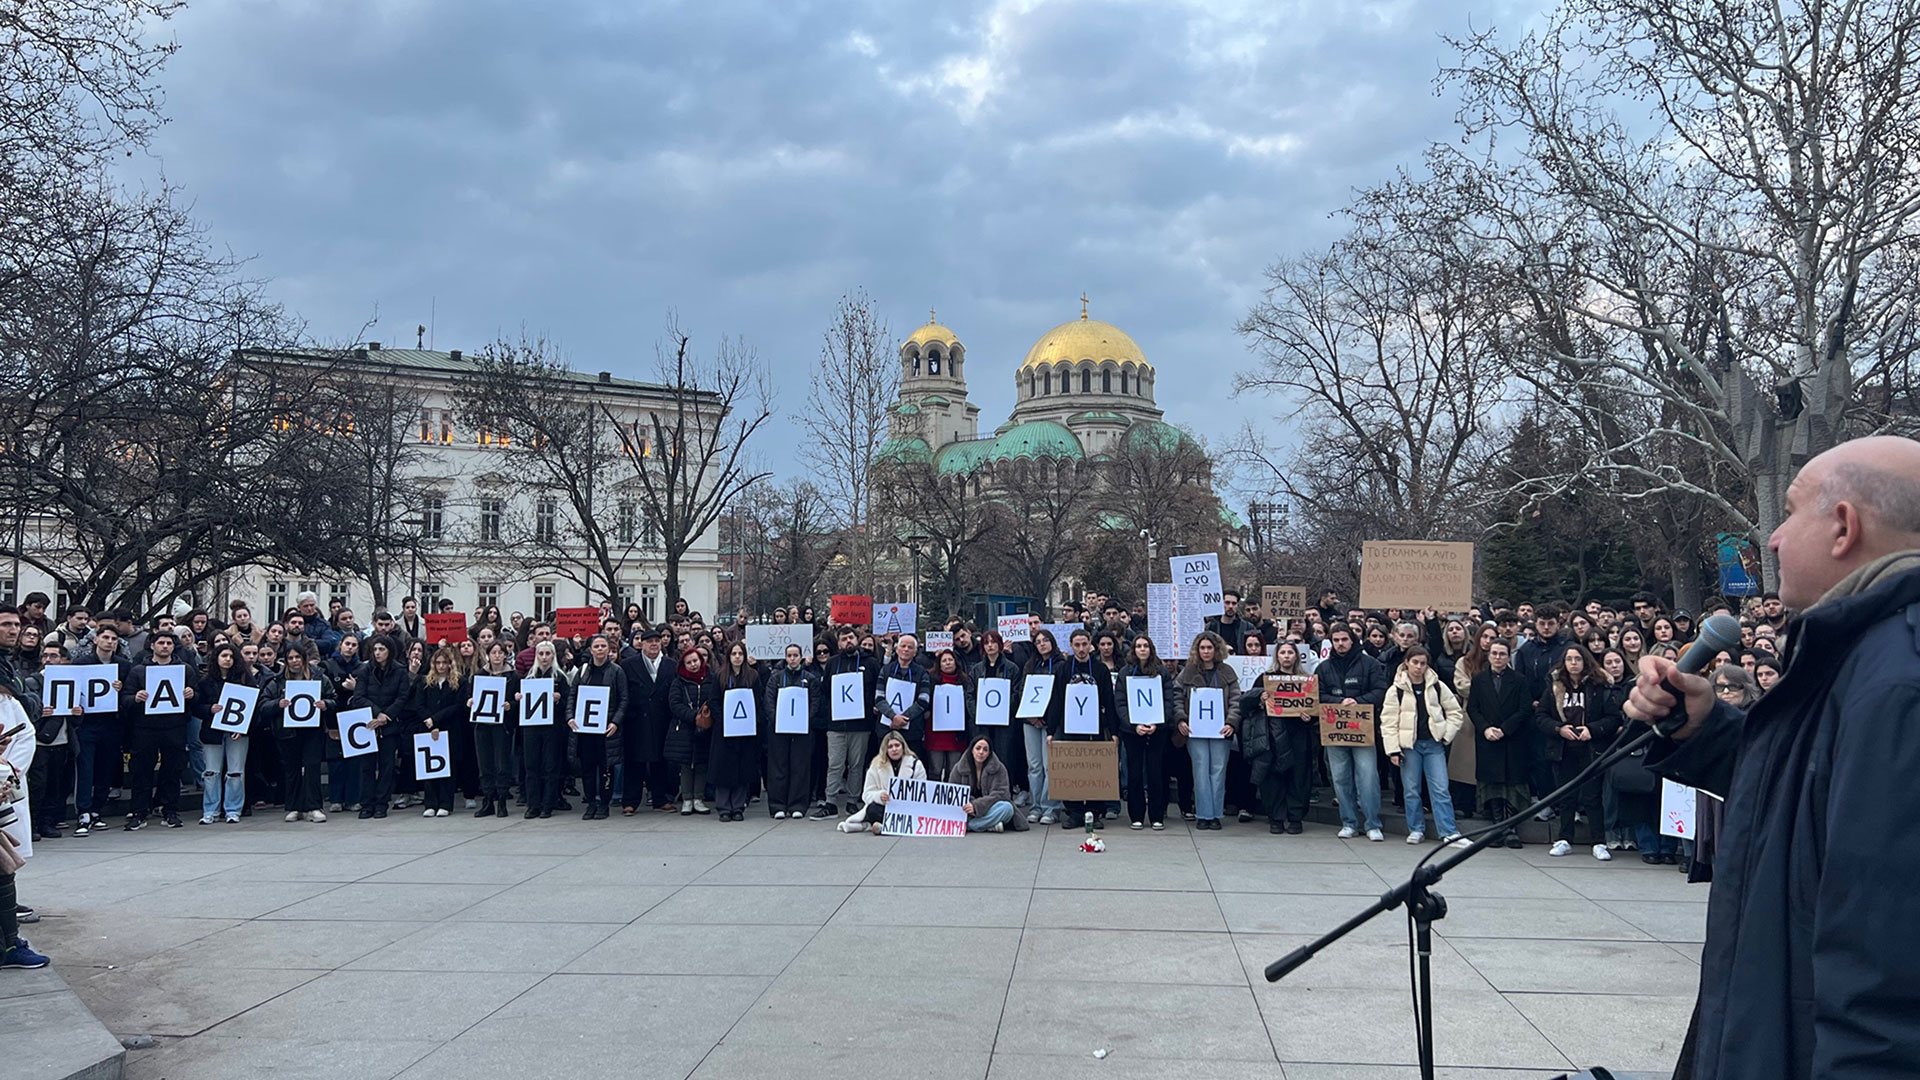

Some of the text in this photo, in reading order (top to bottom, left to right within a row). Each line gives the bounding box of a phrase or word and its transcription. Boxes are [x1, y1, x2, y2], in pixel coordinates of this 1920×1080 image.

[1366, 546, 1457, 559] ΤΟ ΕΓΚΛΗΜΑ ΑΥΤΟ
[1184, 560, 1210, 573] ΔΕΝ
[1368, 561, 1381, 571] ΝΑ
[1385, 561, 1403, 570] ΜΗ
[1264, 591, 1301, 600] ΠΑΡΕ ΜΕ
[877, 610, 888, 619] 57
[767, 626, 791, 636] ΟΧΙ
[769, 635, 792, 646] ΣΤΟ
[748, 645, 812, 656] ΜΠΑΖΑ
[1242, 657, 1266, 666] ΔΕΝ
[1276, 682, 1302, 693] ΔΕΝ
[733, 700, 748, 719] Δ
[841, 684, 855, 703] Κ
[889, 692, 904, 712] Α
[985, 689, 1002, 709] Ο
[1030, 686, 1044, 704] Σ
[1074, 696, 1089, 716] Υ
[1136, 688, 1153, 708] Ν
[1199, 700, 1214, 720] Η
[1273, 697, 1314, 708] ΞΕΧΝΩ
[1326, 708, 1371, 721] ΠΑΡΕ ΜΕ
[51, 679, 602, 774] П Р А В О С Ъ Д И Е
[1336, 721, 1360, 730] ΟΤΑΝ
[1328, 732, 1366, 744] ΦΤΑΣΕΙΣ
[1051, 761, 1102, 771] ΕΓΚΛΗΜΑΤΙΚΗ
[1052, 777, 1112, 789] ΤΡΟΜΟΚΡΑΤΙΑ
[888, 778, 970, 807] ΚΑΜΙΑ ΑΝΟΧΗ
[881, 812, 913, 834] ΚΑΜΙΑ
